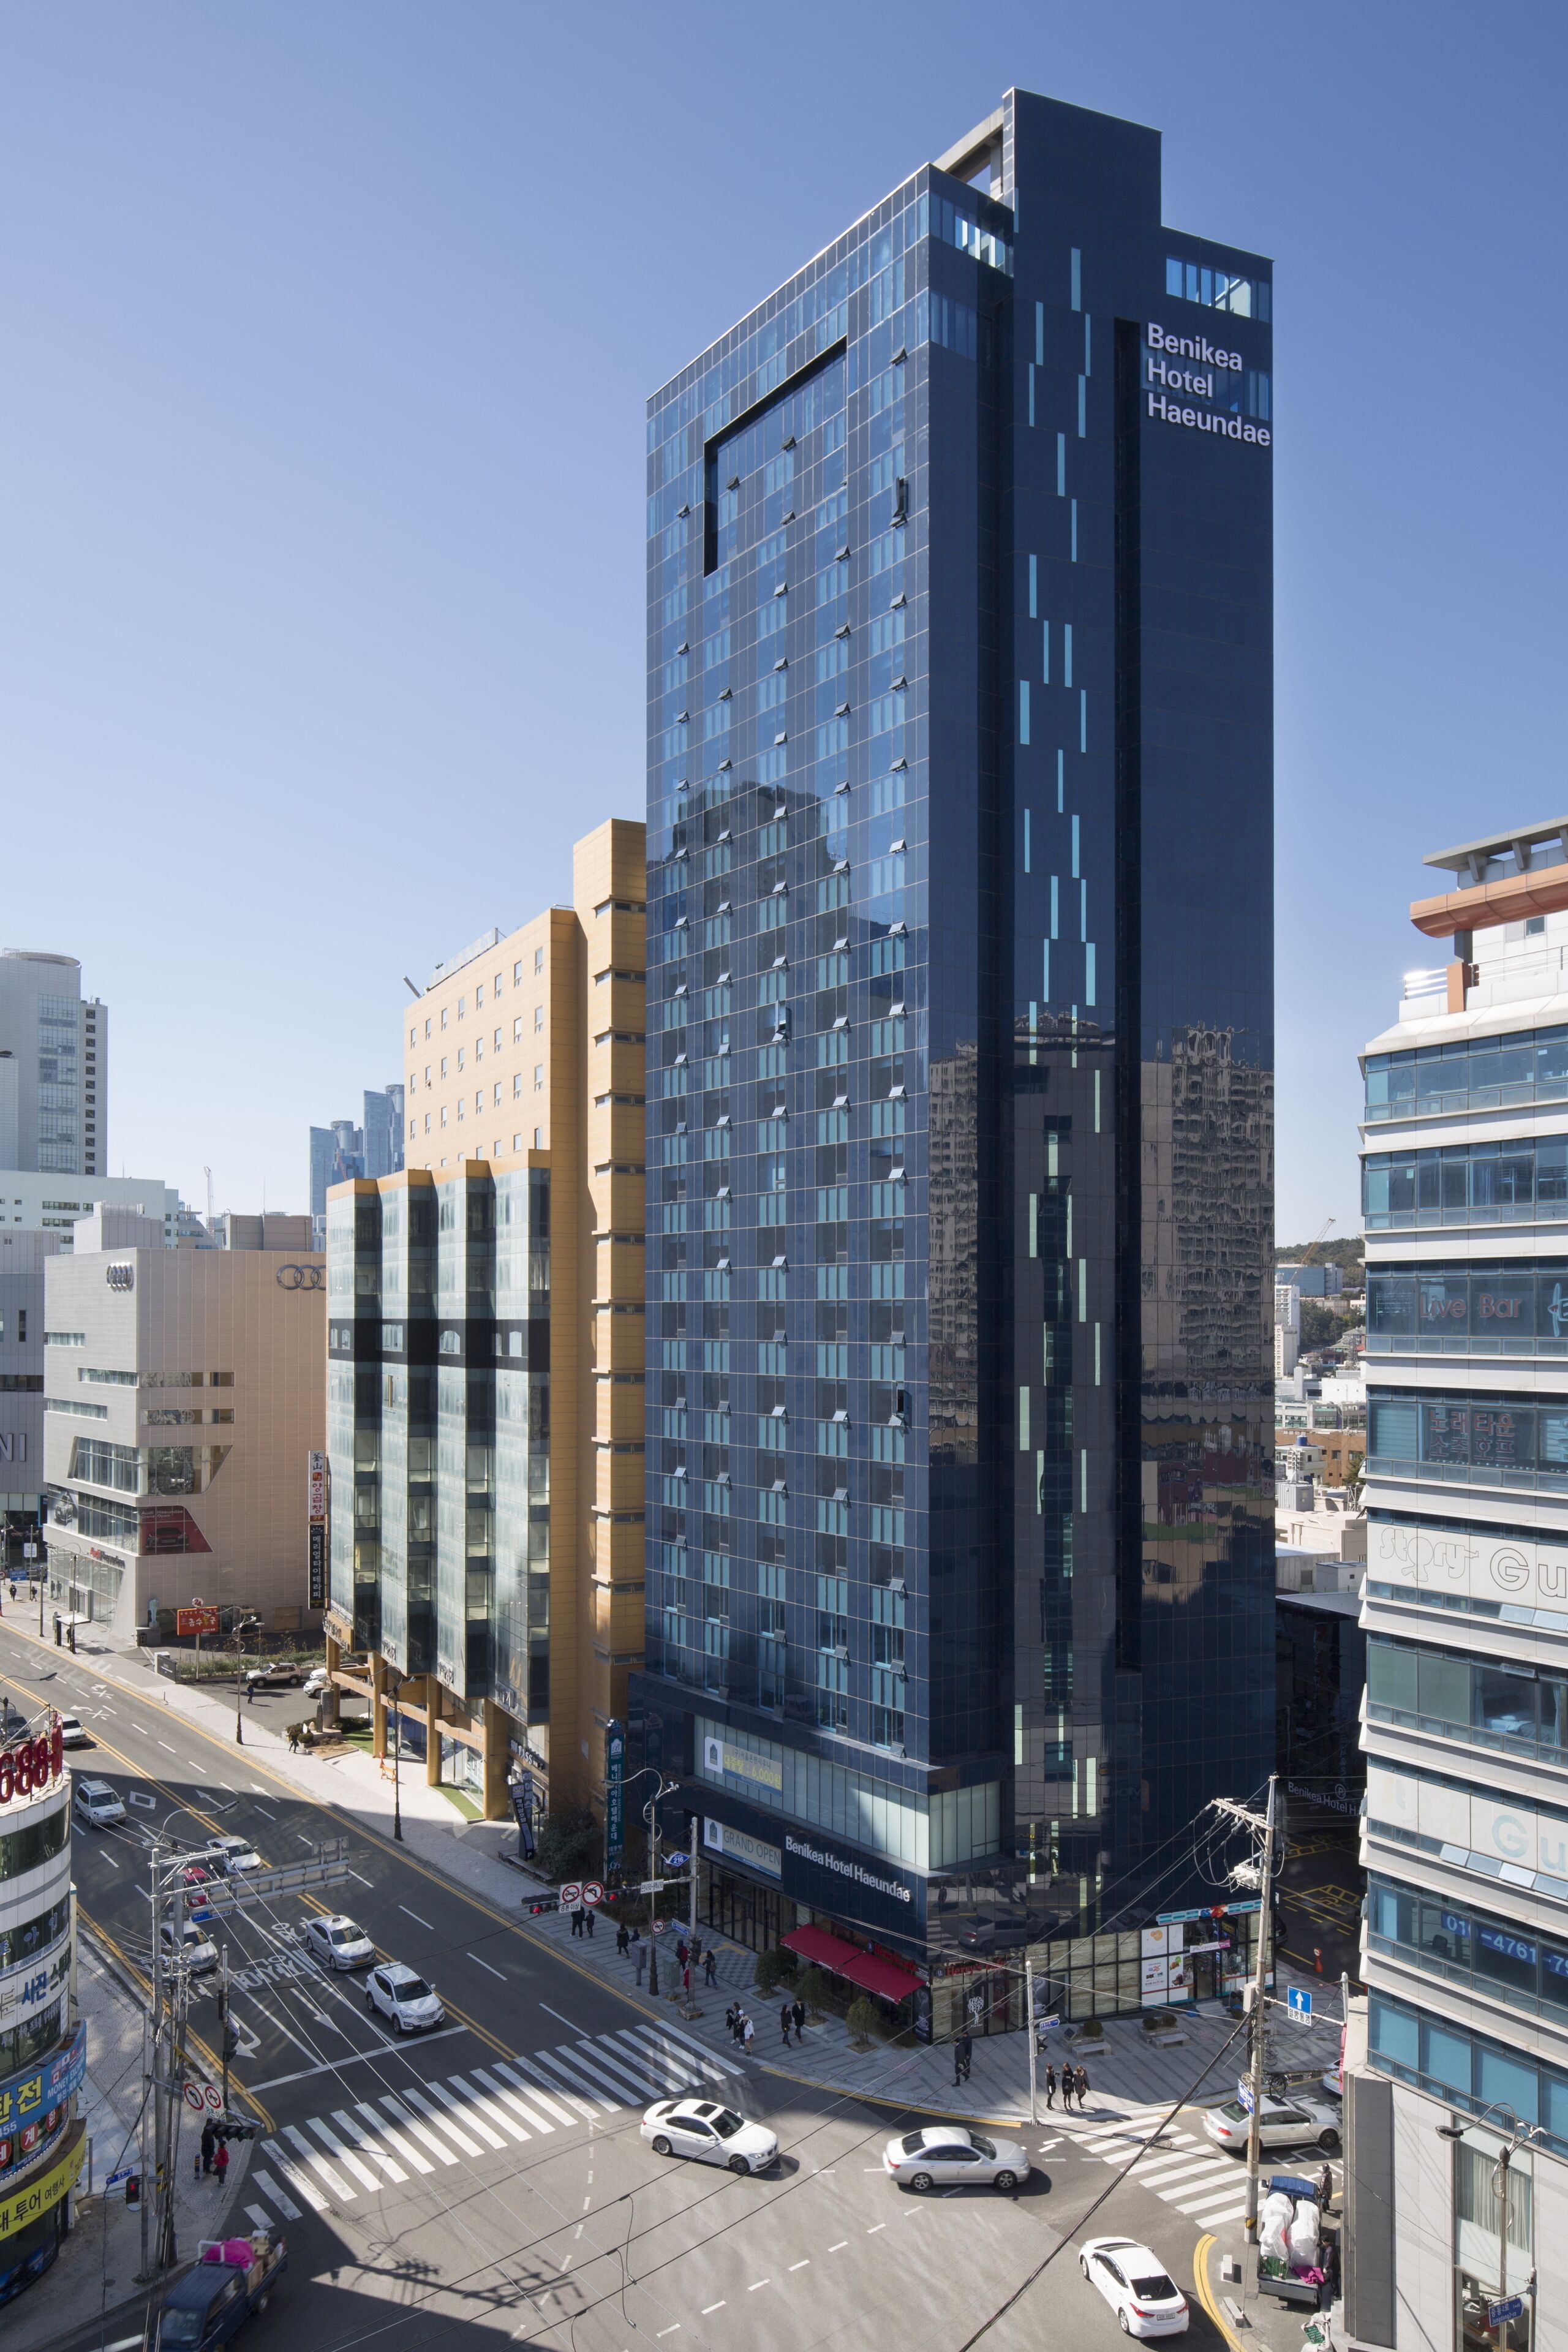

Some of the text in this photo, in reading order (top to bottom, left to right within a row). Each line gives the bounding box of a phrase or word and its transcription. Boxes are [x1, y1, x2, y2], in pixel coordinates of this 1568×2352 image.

[1148, 322, 1242, 371] Benikea
[1148, 358, 1213, 398] Hotel
[1148, 393, 1271, 447] Haeundae
[1420, 1294, 1522, 1318] Live Bar
[1430, 1409, 1516, 1438] 노래타운
[1429, 1435, 1516, 1463] 소주호프
[312, 1482, 323, 1514] 양곱창
[1380, 1528, 1567, 1599] Story Gu
[724, 1754, 744, 1774] 대중탕
[752, 1765, 782, 1789] 6,000원
[1288, 1781, 1322, 1803] Benikea
[1323, 1794, 1348, 1813] Hotel
[723, 1830, 754, 1853] GRAND
[756, 1844, 781, 1867] OPEN
[786, 1836, 911, 1902] Benikea Hotel Haeundae
[1200, 1904, 1226, 1918] GS25
[1446, 1915, 1568, 1973] 01-4761-7
[22, 1970, 47, 2005] 사진
[1289, 2008, 1310, 2024] 일방통행
[47, 2075, 69, 2099] MONEY
[13, 2188, 41, 2222] 투어
[44, 2175, 65, 2200] 여행사
[1491, 2303, 1510, 2318] 중동2로
